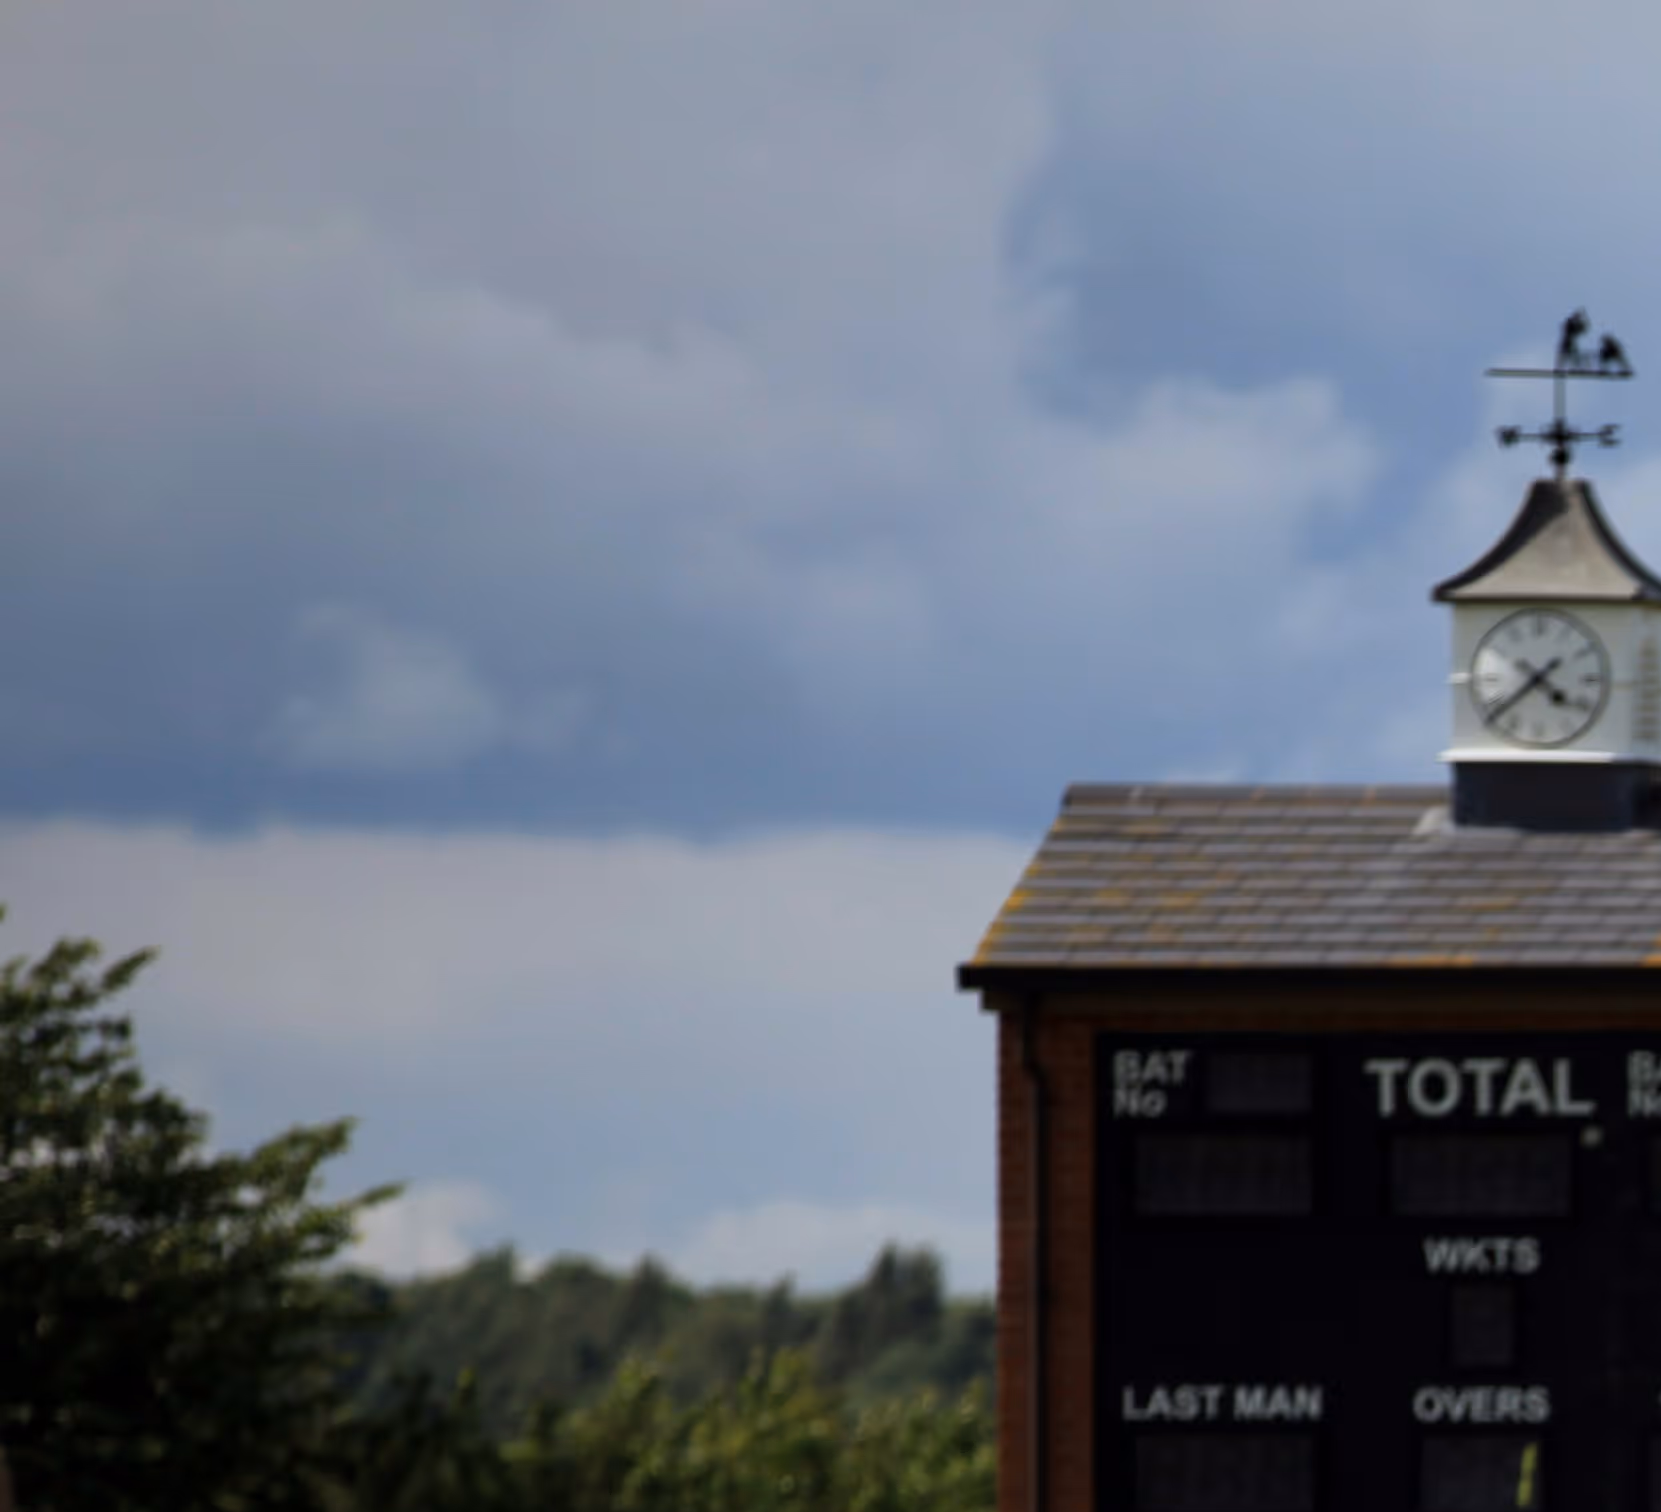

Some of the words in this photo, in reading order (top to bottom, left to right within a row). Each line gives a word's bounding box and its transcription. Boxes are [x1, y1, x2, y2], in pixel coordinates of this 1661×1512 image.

[1115, 1052, 1186, 1083] BAT
[1114, 1086, 1165, 1117] No
[1365, 1058, 1594, 1116] TOTAL
[1425, 1238, 1539, 1272] WKTS
[1123, 1386, 1221, 1420] LAST
[1234, 1386, 1322, 1420] MAN
[1413, 1387, 1550, 1422] OVERS
[1517, 1444, 1537, 1508] 1
